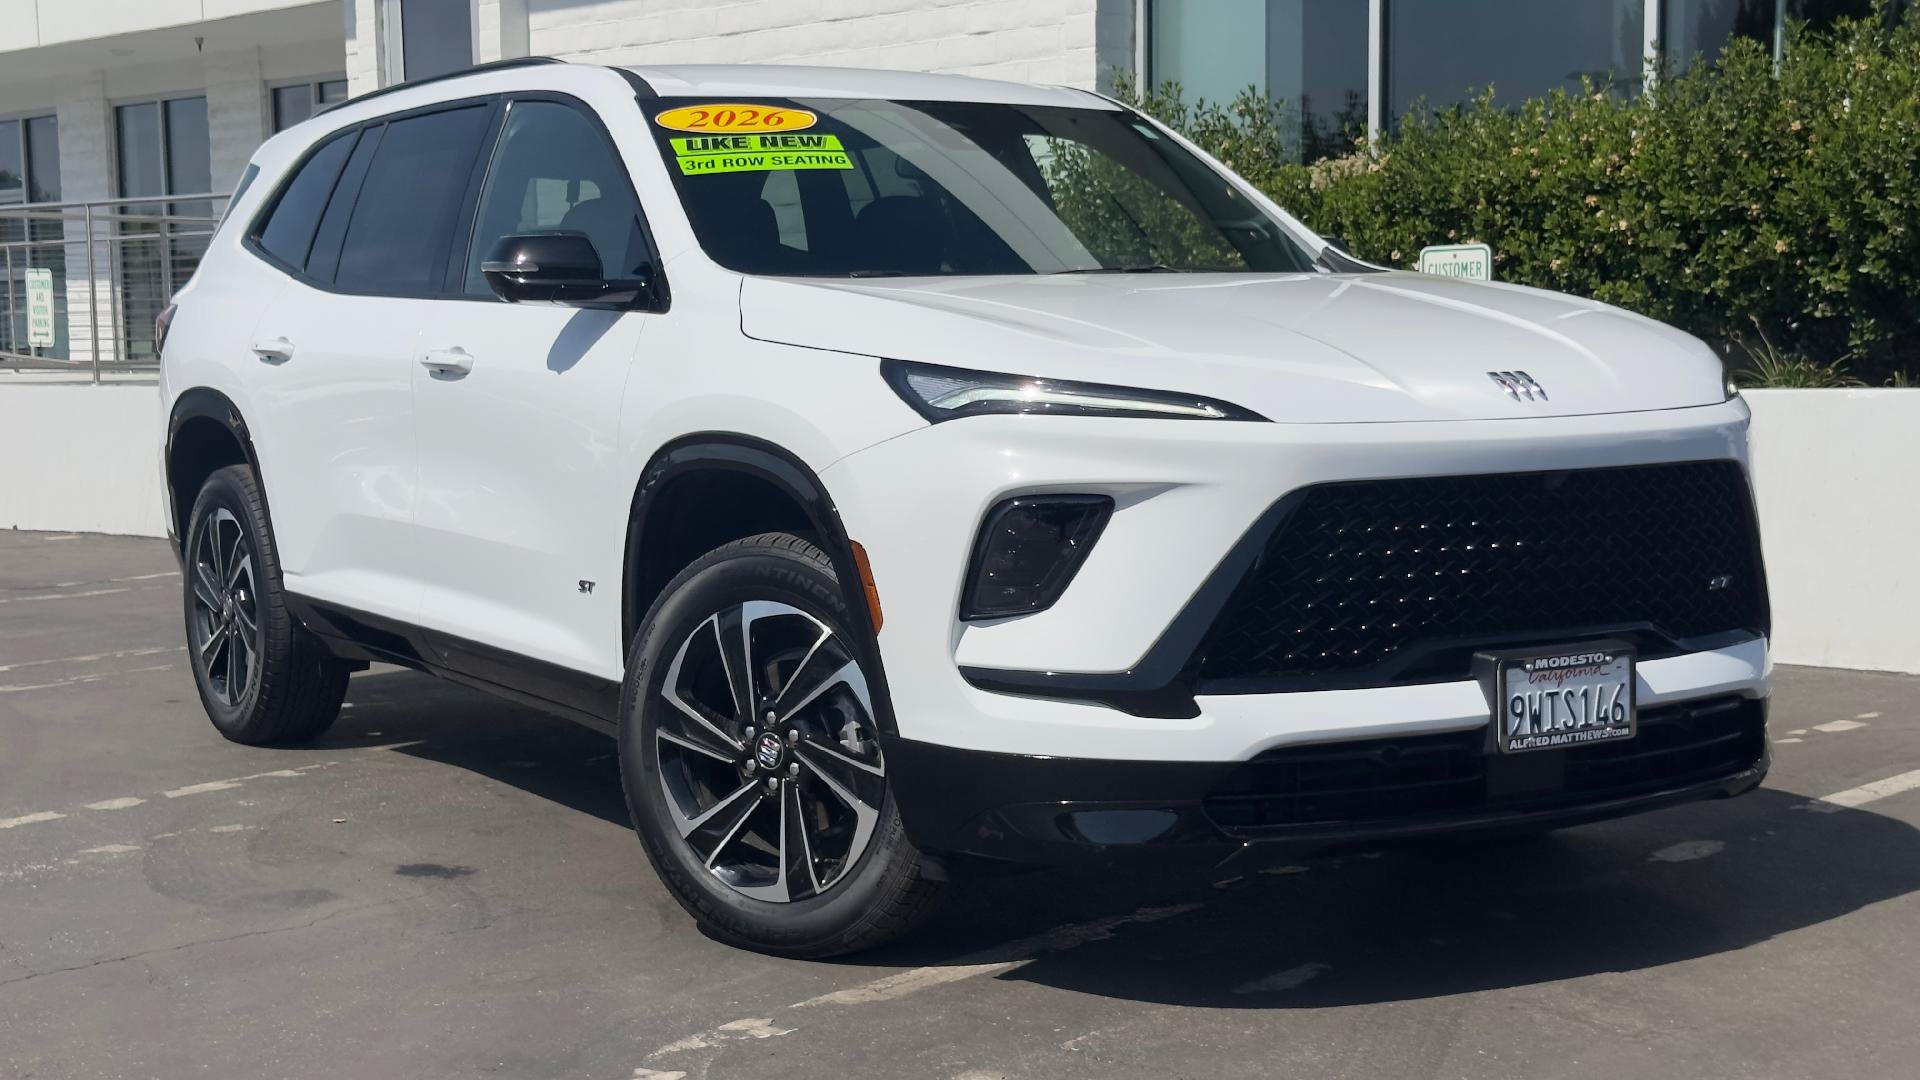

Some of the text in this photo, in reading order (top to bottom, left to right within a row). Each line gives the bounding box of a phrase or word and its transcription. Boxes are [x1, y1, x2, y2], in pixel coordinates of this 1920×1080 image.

[687, 109, 785, 128] 2026
[685, 135, 824, 151] LIKE NEW
[685, 154, 847, 170] 3rd ROW SEATING
[1429, 261, 1482, 277] CUSTOMER
[578, 580, 595, 595] ST
[1534, 652, 1605, 669] MODESTO
[1528, 665, 1610, 687] California
[1509, 682, 1626, 737] 9WIS146
[1509, 736, 1550, 750] ALFRED
